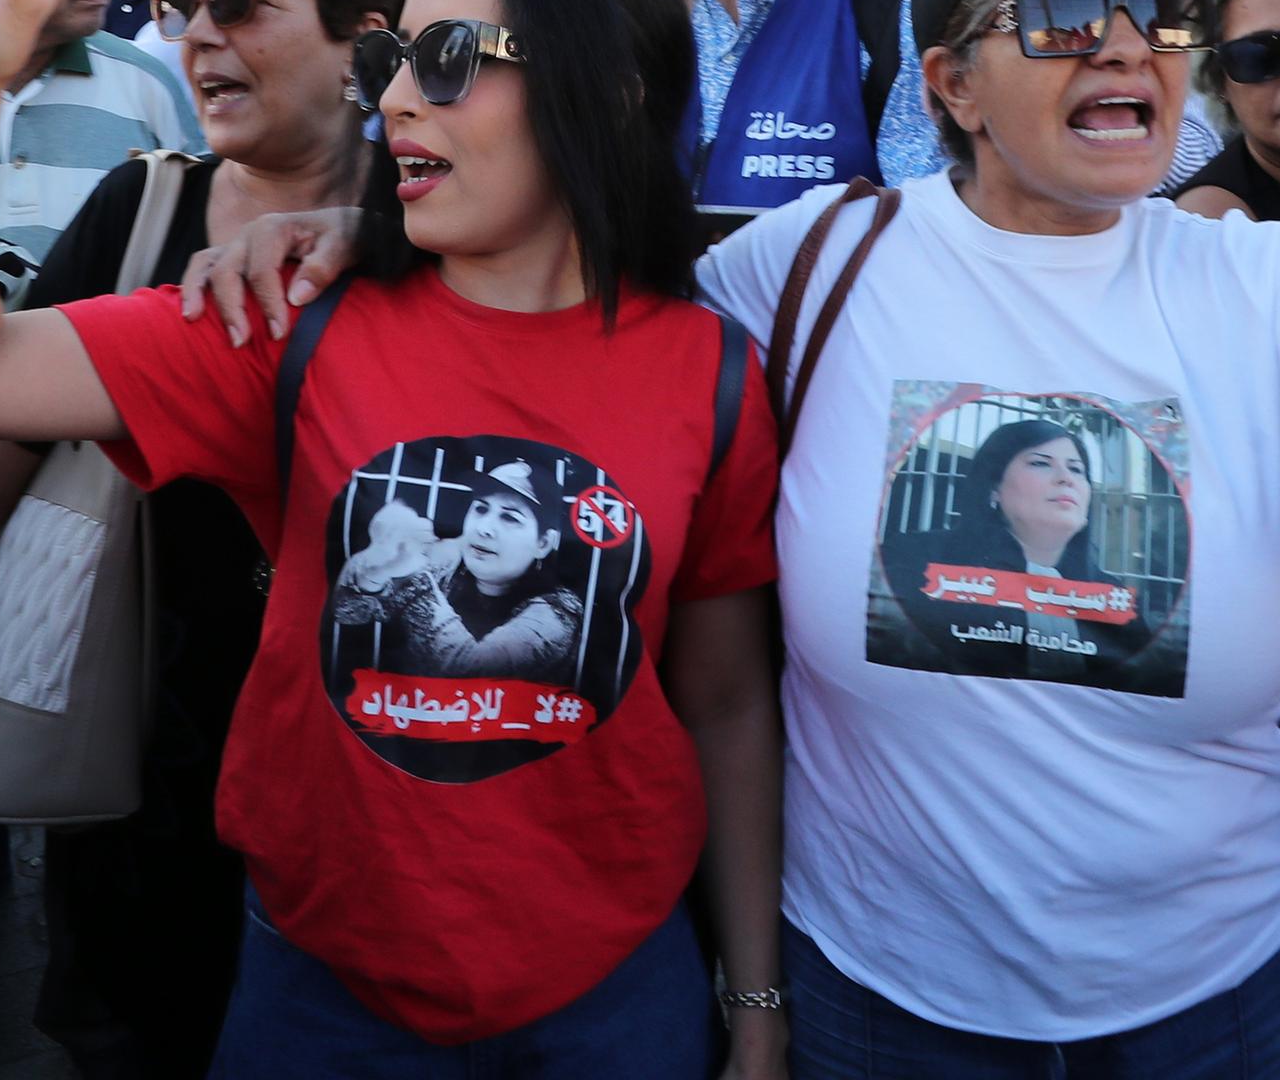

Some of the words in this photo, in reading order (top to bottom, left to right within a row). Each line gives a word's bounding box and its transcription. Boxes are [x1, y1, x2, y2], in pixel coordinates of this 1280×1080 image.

[745, 110, 837, 141] صحافة
[740, 153, 836, 180] PRESS
[949, 620, 1024, 646] الشعب
[1025, 626, 1099, 656] محامية
